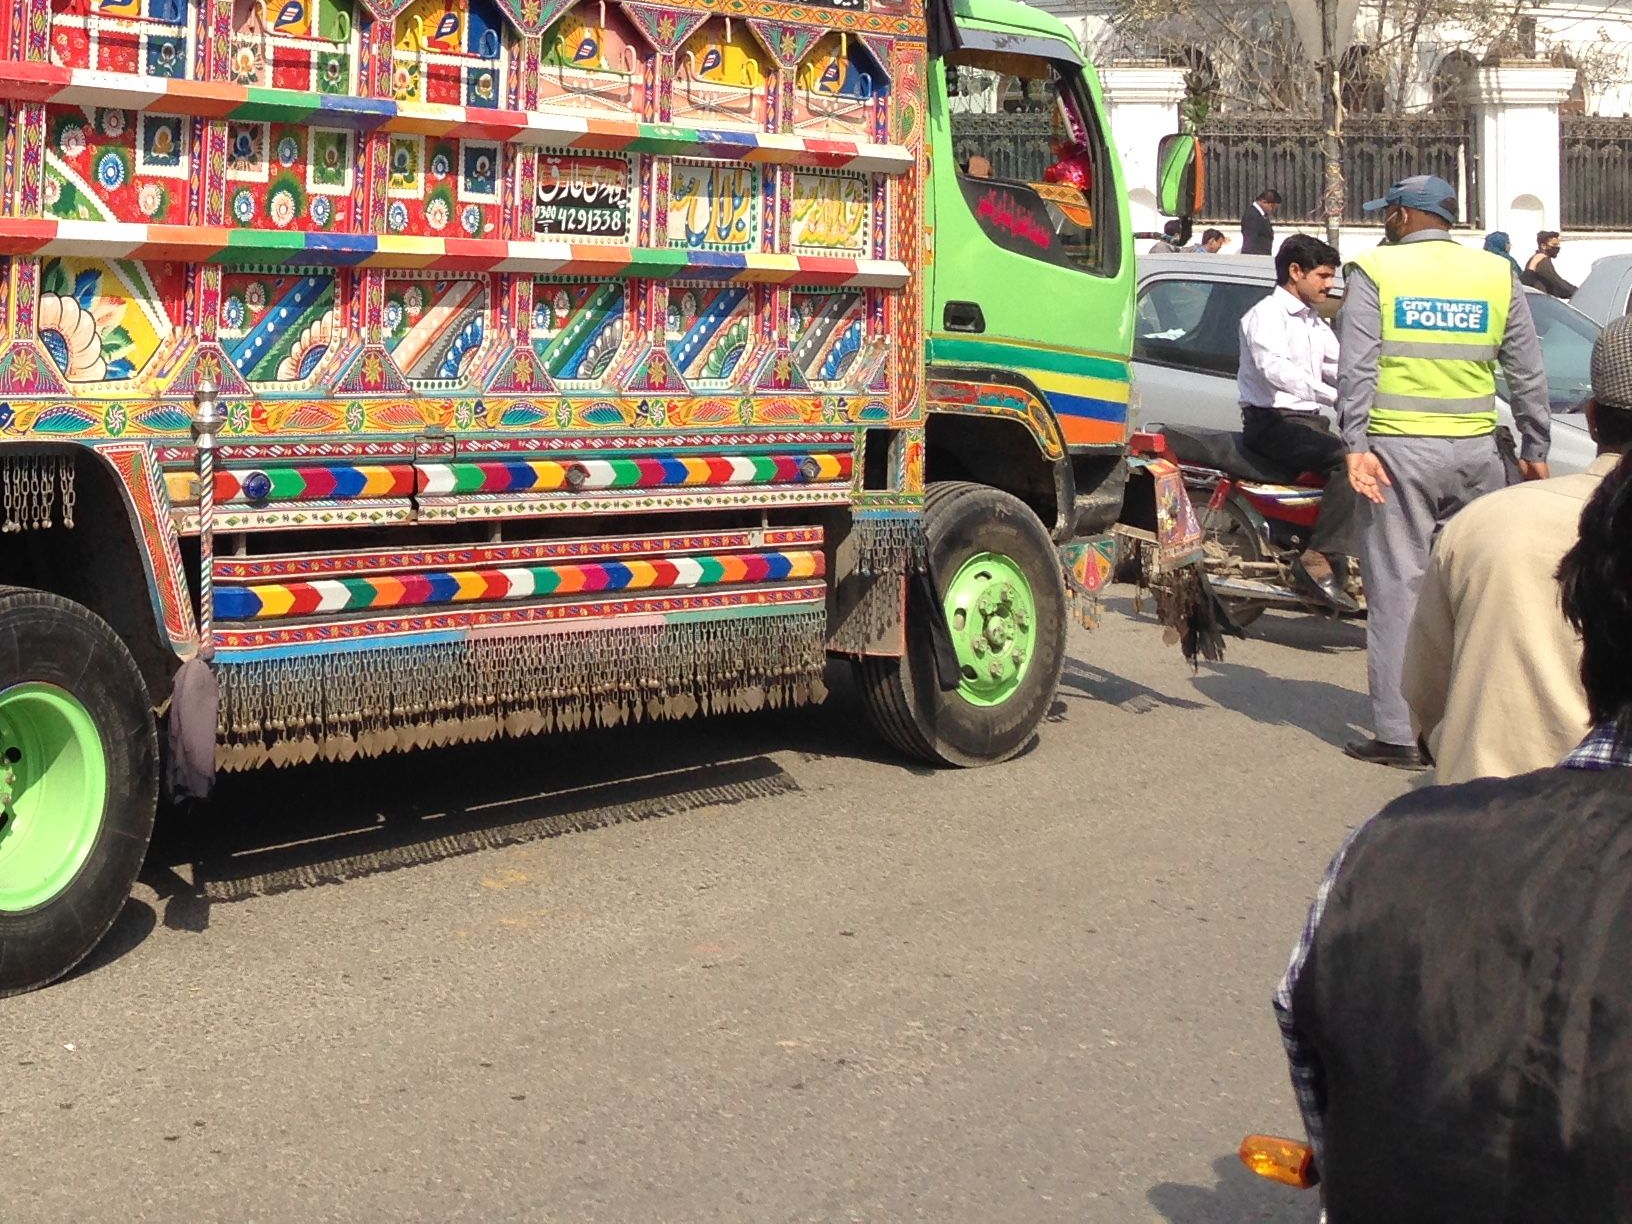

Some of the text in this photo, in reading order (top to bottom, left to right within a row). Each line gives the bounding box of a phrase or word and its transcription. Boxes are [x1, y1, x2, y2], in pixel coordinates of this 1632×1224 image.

[557, 208, 622, 233] 4291338
[1402, 300, 1484, 314] CITY TRAFFIC
[1405, 310, 1481, 329] POLICE
